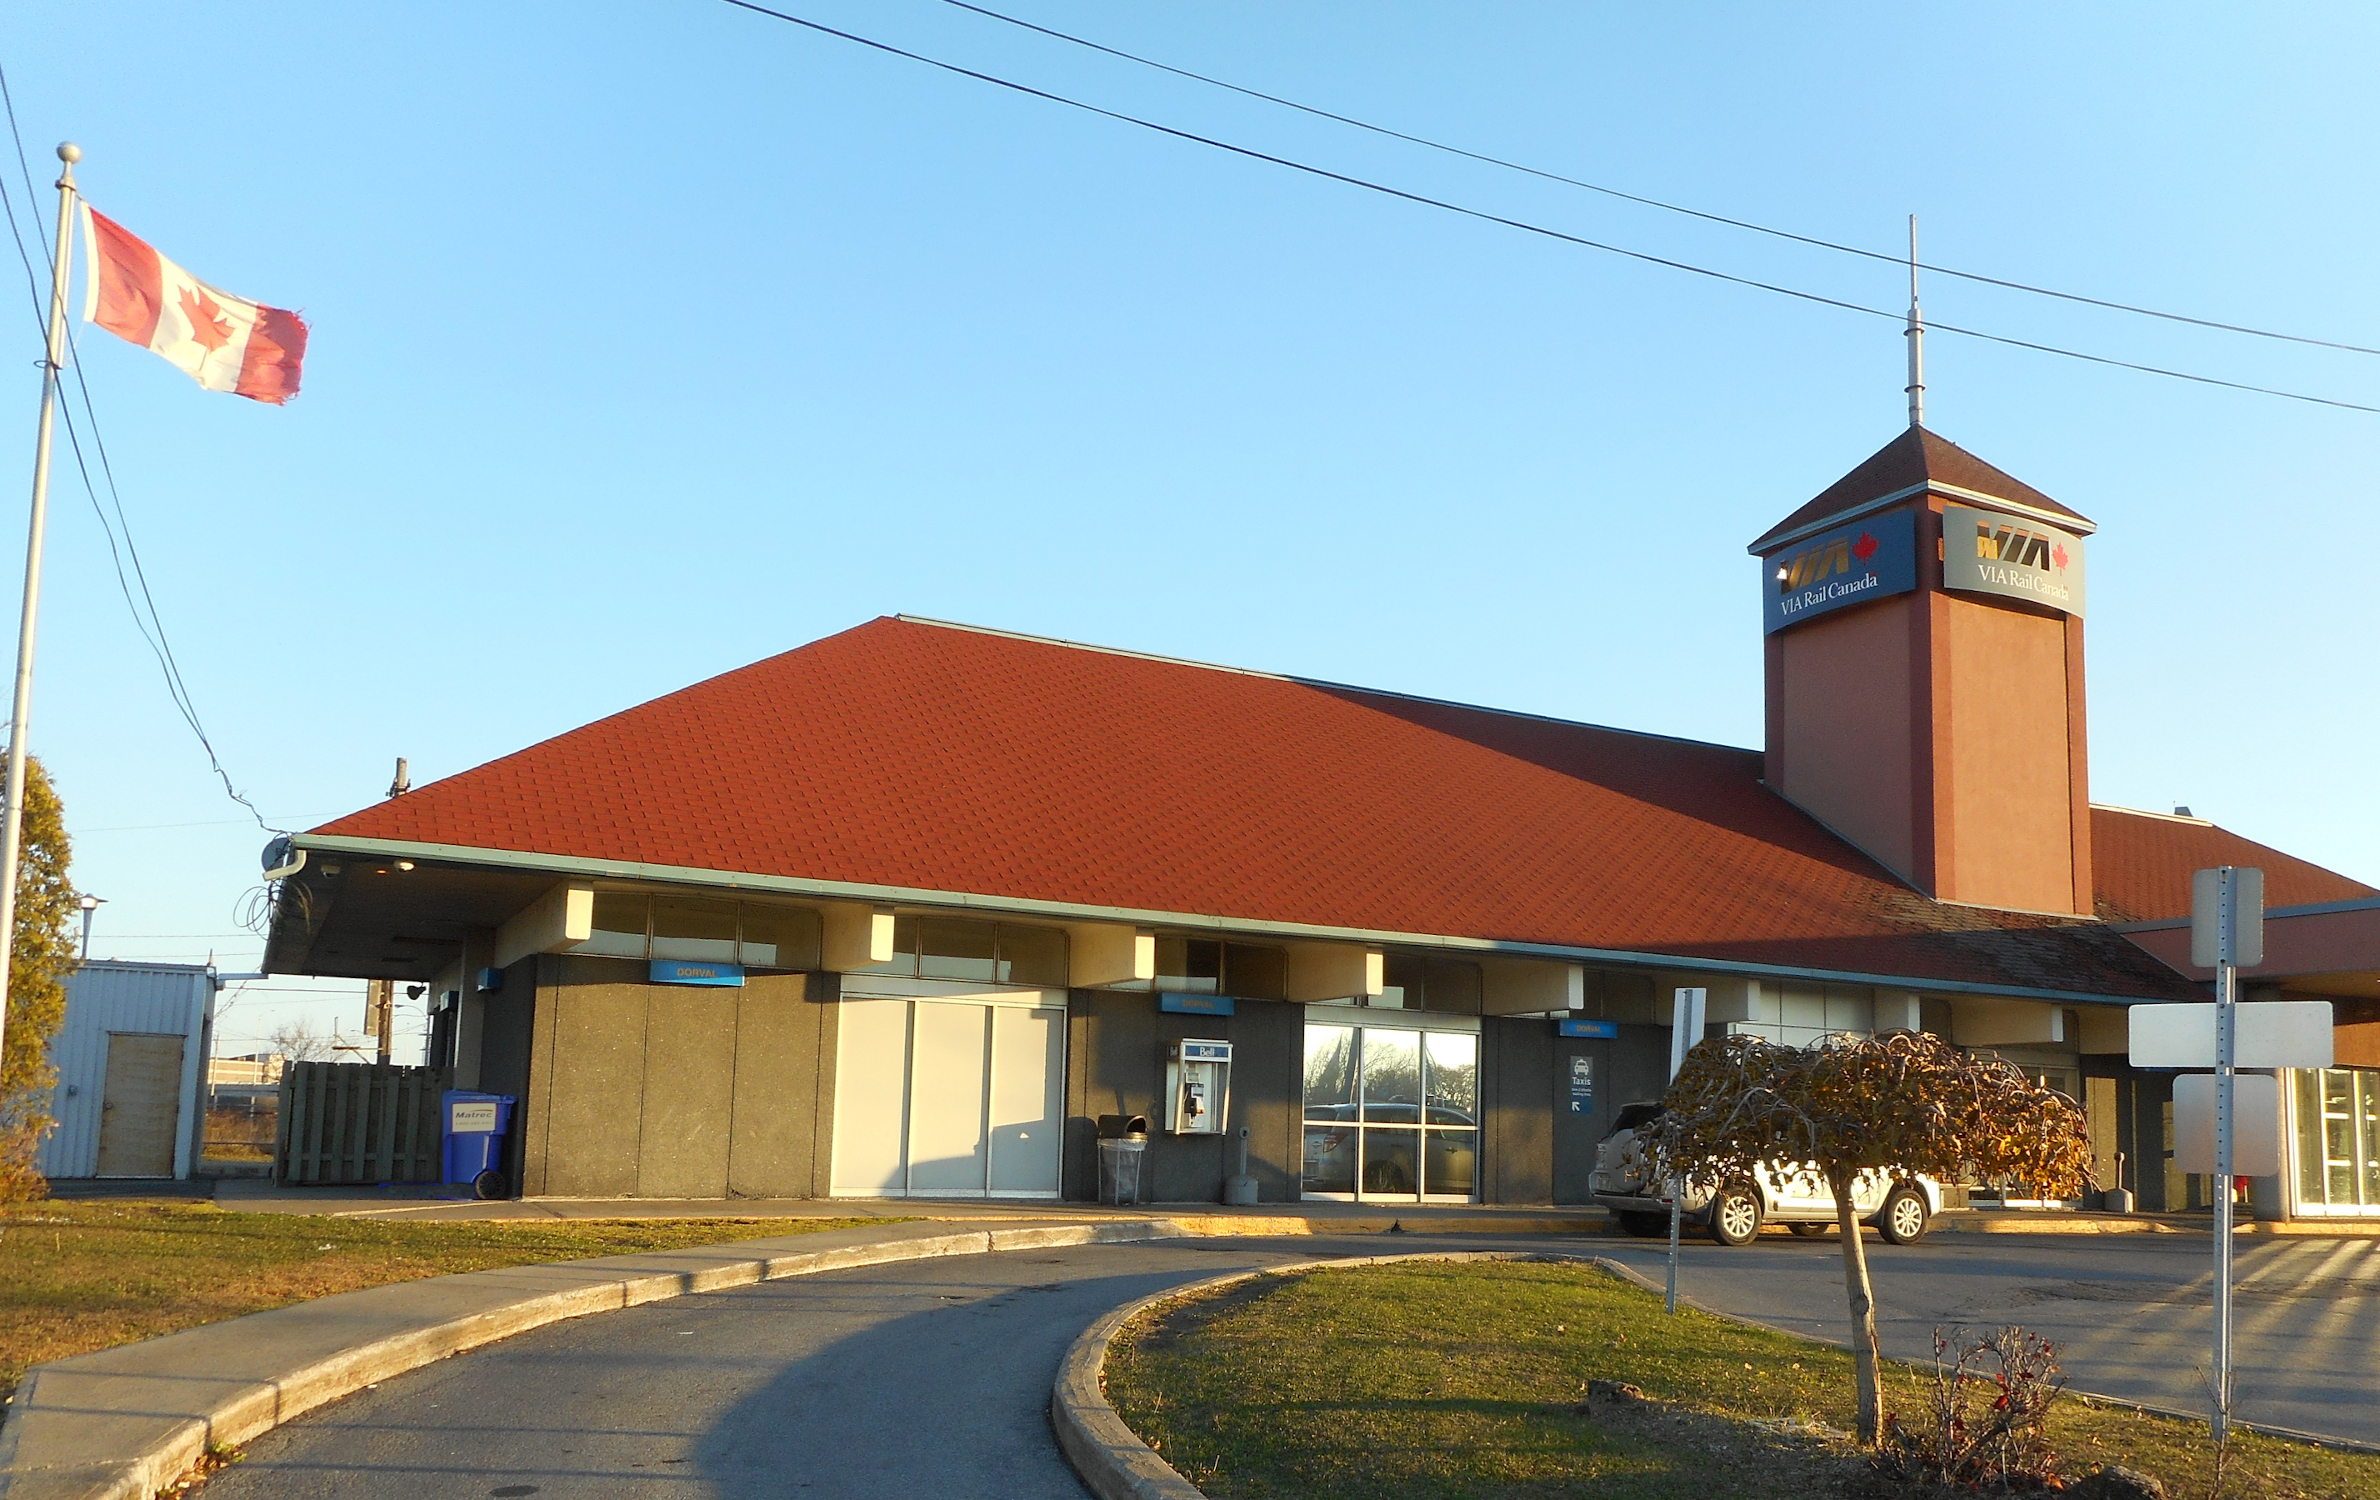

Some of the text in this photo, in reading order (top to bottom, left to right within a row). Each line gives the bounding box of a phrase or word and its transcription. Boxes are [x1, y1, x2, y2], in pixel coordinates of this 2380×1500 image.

[1978, 565, 2069, 601] VIA Rail Canada
[1781, 572, 1878, 616] VIA Rail Canada
[677, 967, 719, 978] DORVAL
[1200, 1047, 1214, 1057] Bell
[1572, 1076, 1591, 1086] Taxis
[455, 1111, 492, 1119] Matrec
